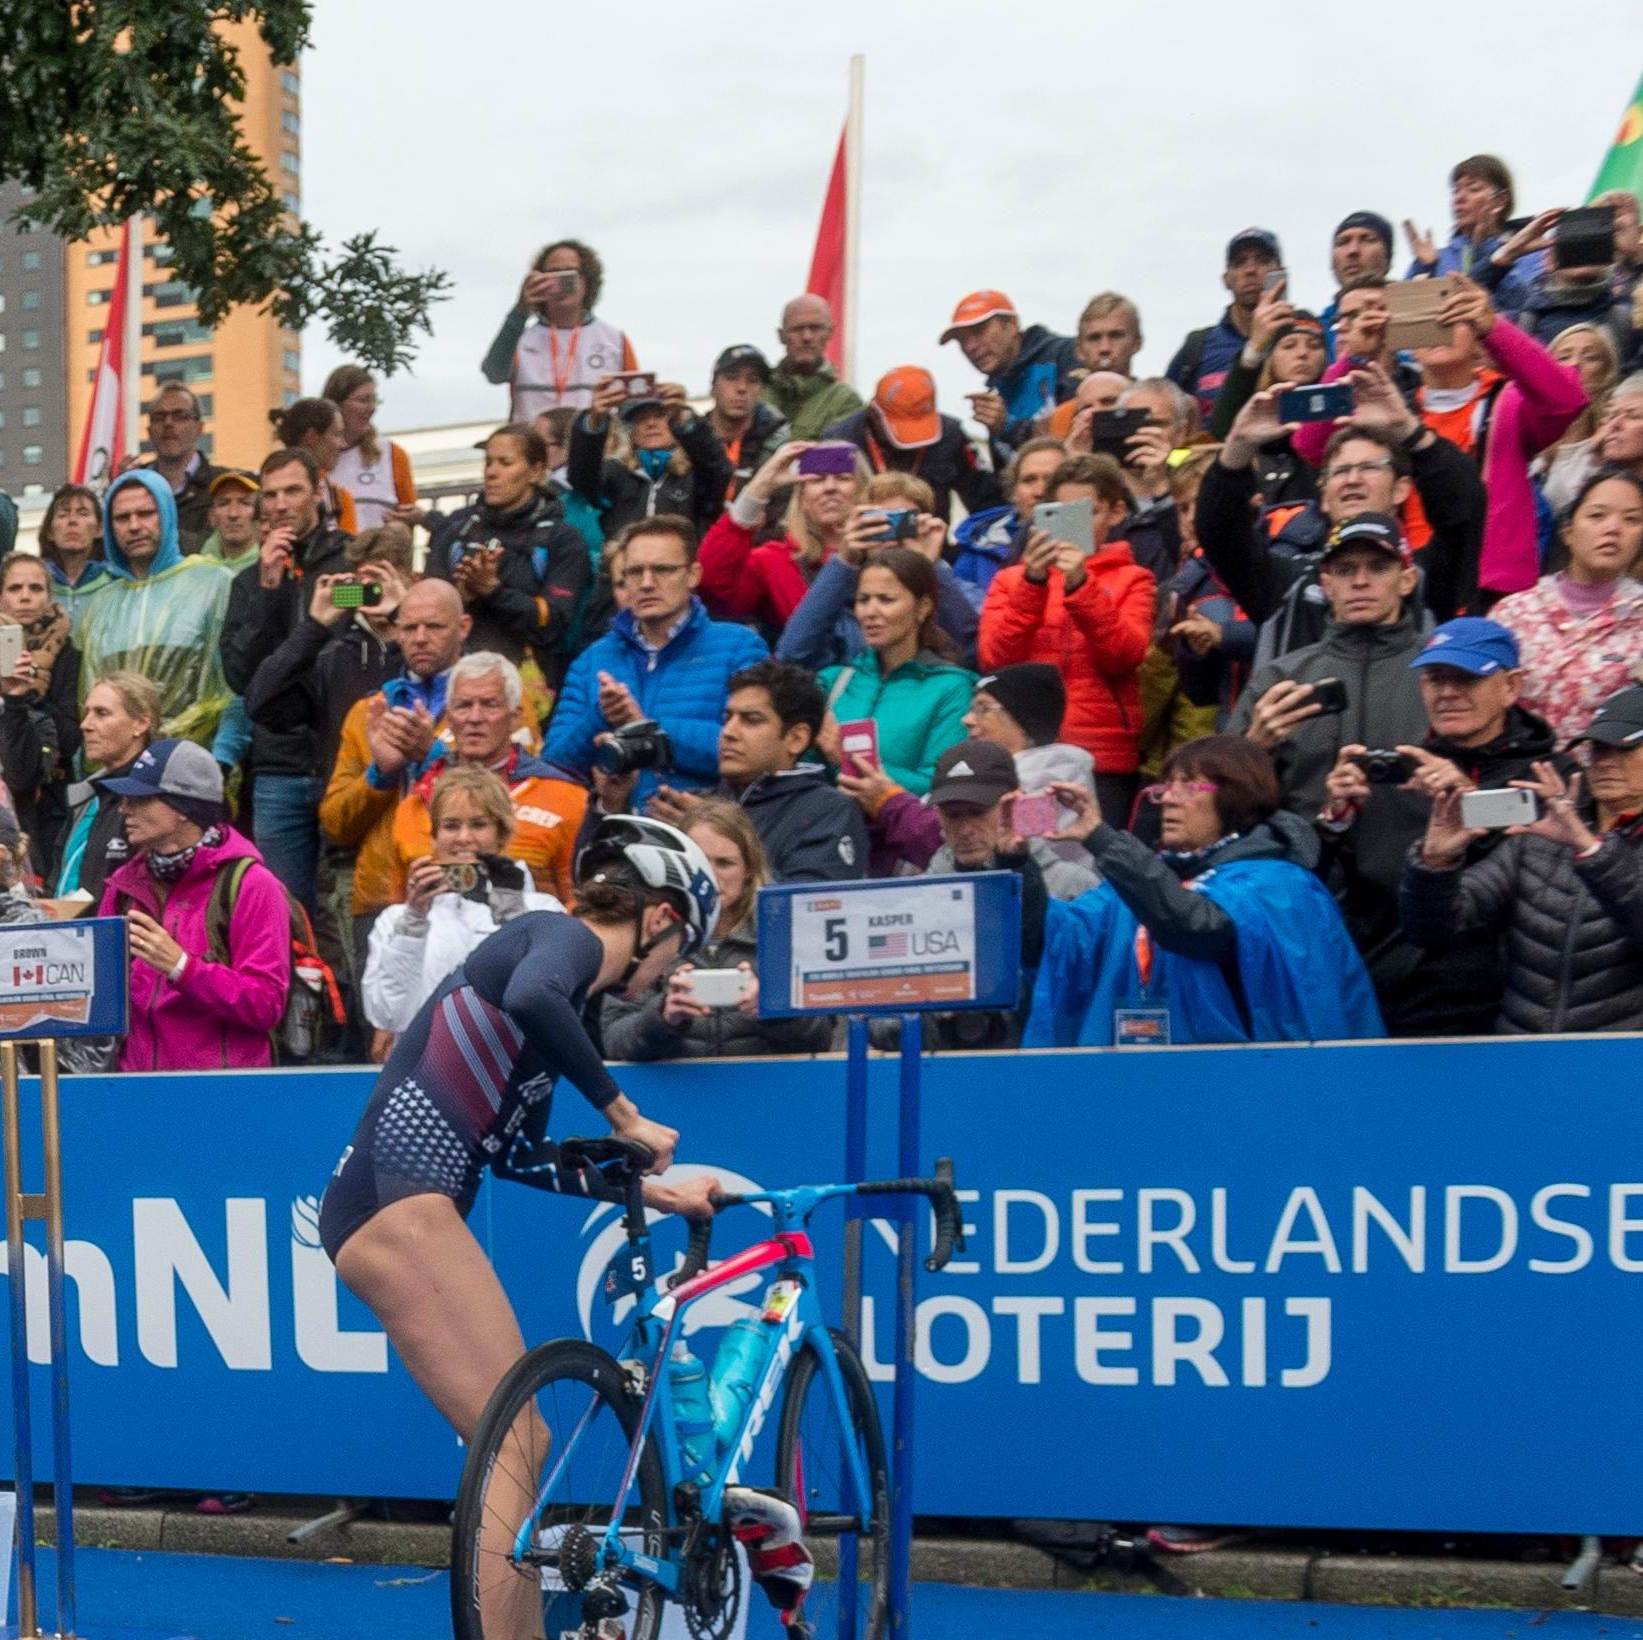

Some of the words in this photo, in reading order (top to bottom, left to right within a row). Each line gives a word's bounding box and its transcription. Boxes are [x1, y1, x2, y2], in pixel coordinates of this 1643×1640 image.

[869, 913, 913, 928] KASPER
[825, 917, 849, 962] 5
[911, 930, 961, 957] USA
[13, 947, 47, 960] BROWN
[46, 963, 85, 986] CAN
[631, 1256, 646, 1281] 5
[861, 1296, 1332, 1388] LOTERIJ
